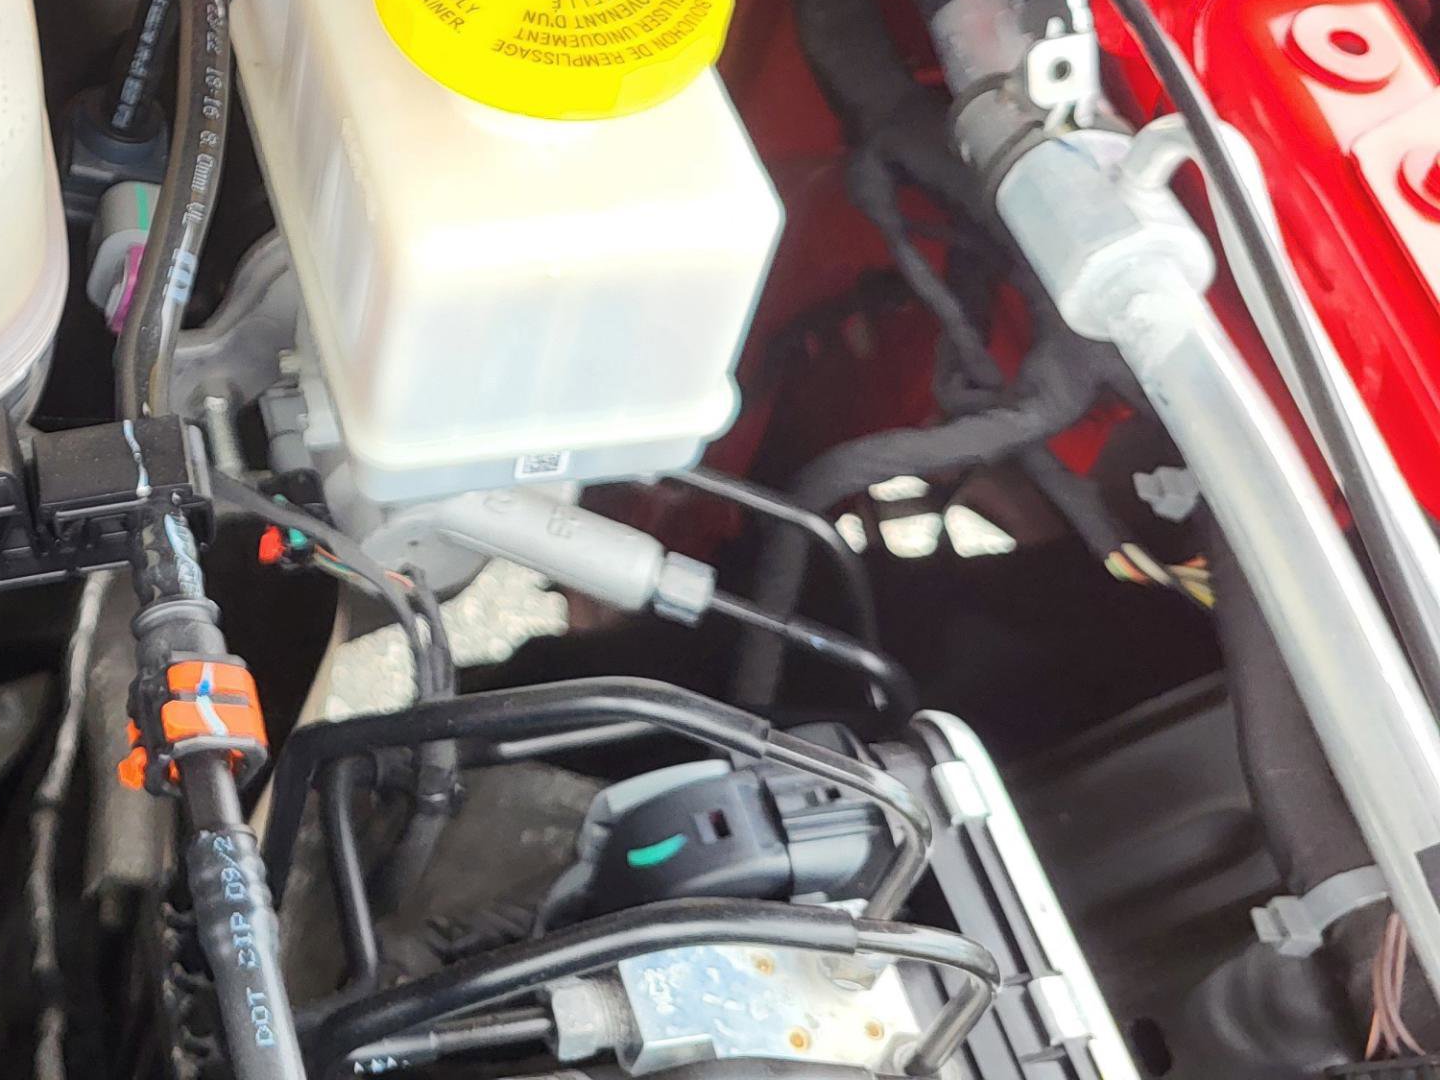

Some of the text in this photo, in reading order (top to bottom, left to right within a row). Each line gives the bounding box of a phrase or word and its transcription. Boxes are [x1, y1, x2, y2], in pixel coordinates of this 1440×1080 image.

[522, 9, 567, 29] D'UN
[513, 25, 637, 48] UNIQUEMENT
[491, 38, 625, 67] REMPLISSAGE
[626, 43, 653, 60] DE
